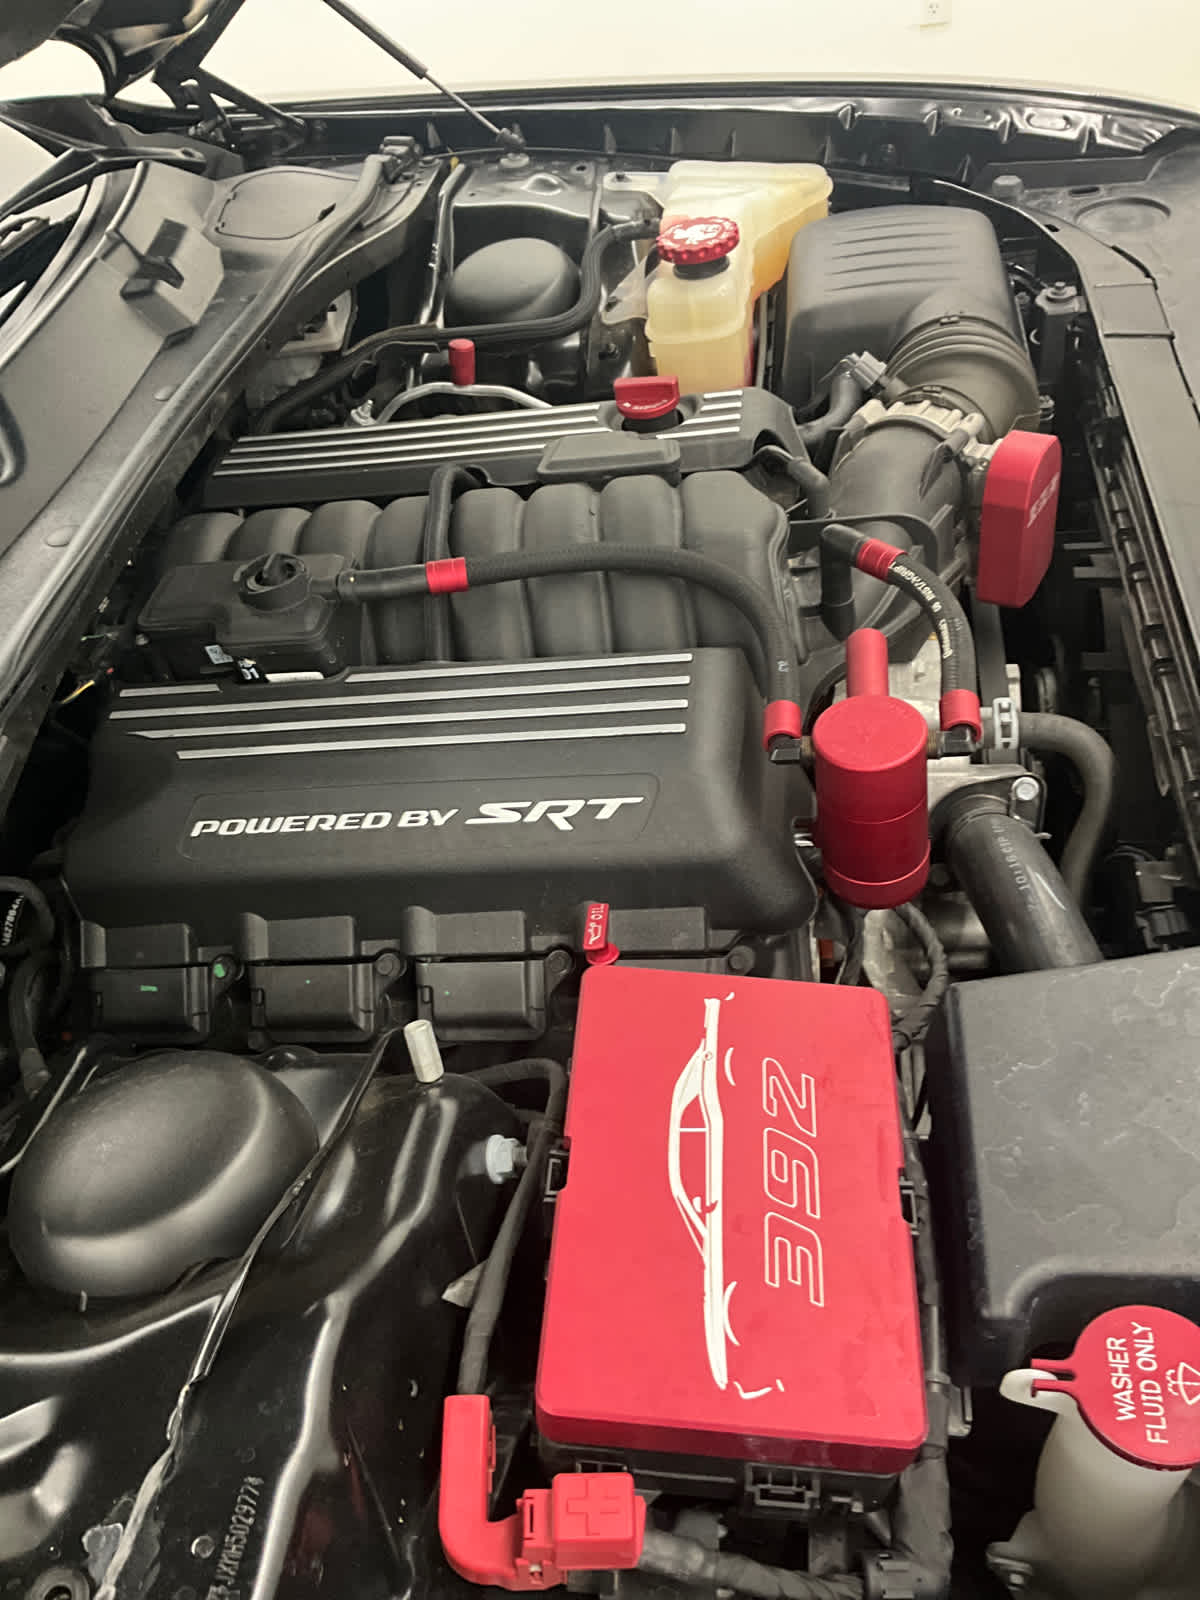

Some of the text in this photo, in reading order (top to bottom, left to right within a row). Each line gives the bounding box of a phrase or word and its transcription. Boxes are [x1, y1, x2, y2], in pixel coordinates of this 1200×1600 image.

[190, 796, 644, 837] POWERED BY SRT
[590, 904, 605, 920] OIL
[762, 1056, 824, 1307] 392
[1106, 1337, 1137, 1421] WASHER
[1131, 1321, 1169, 1444] FLUID ONLY
